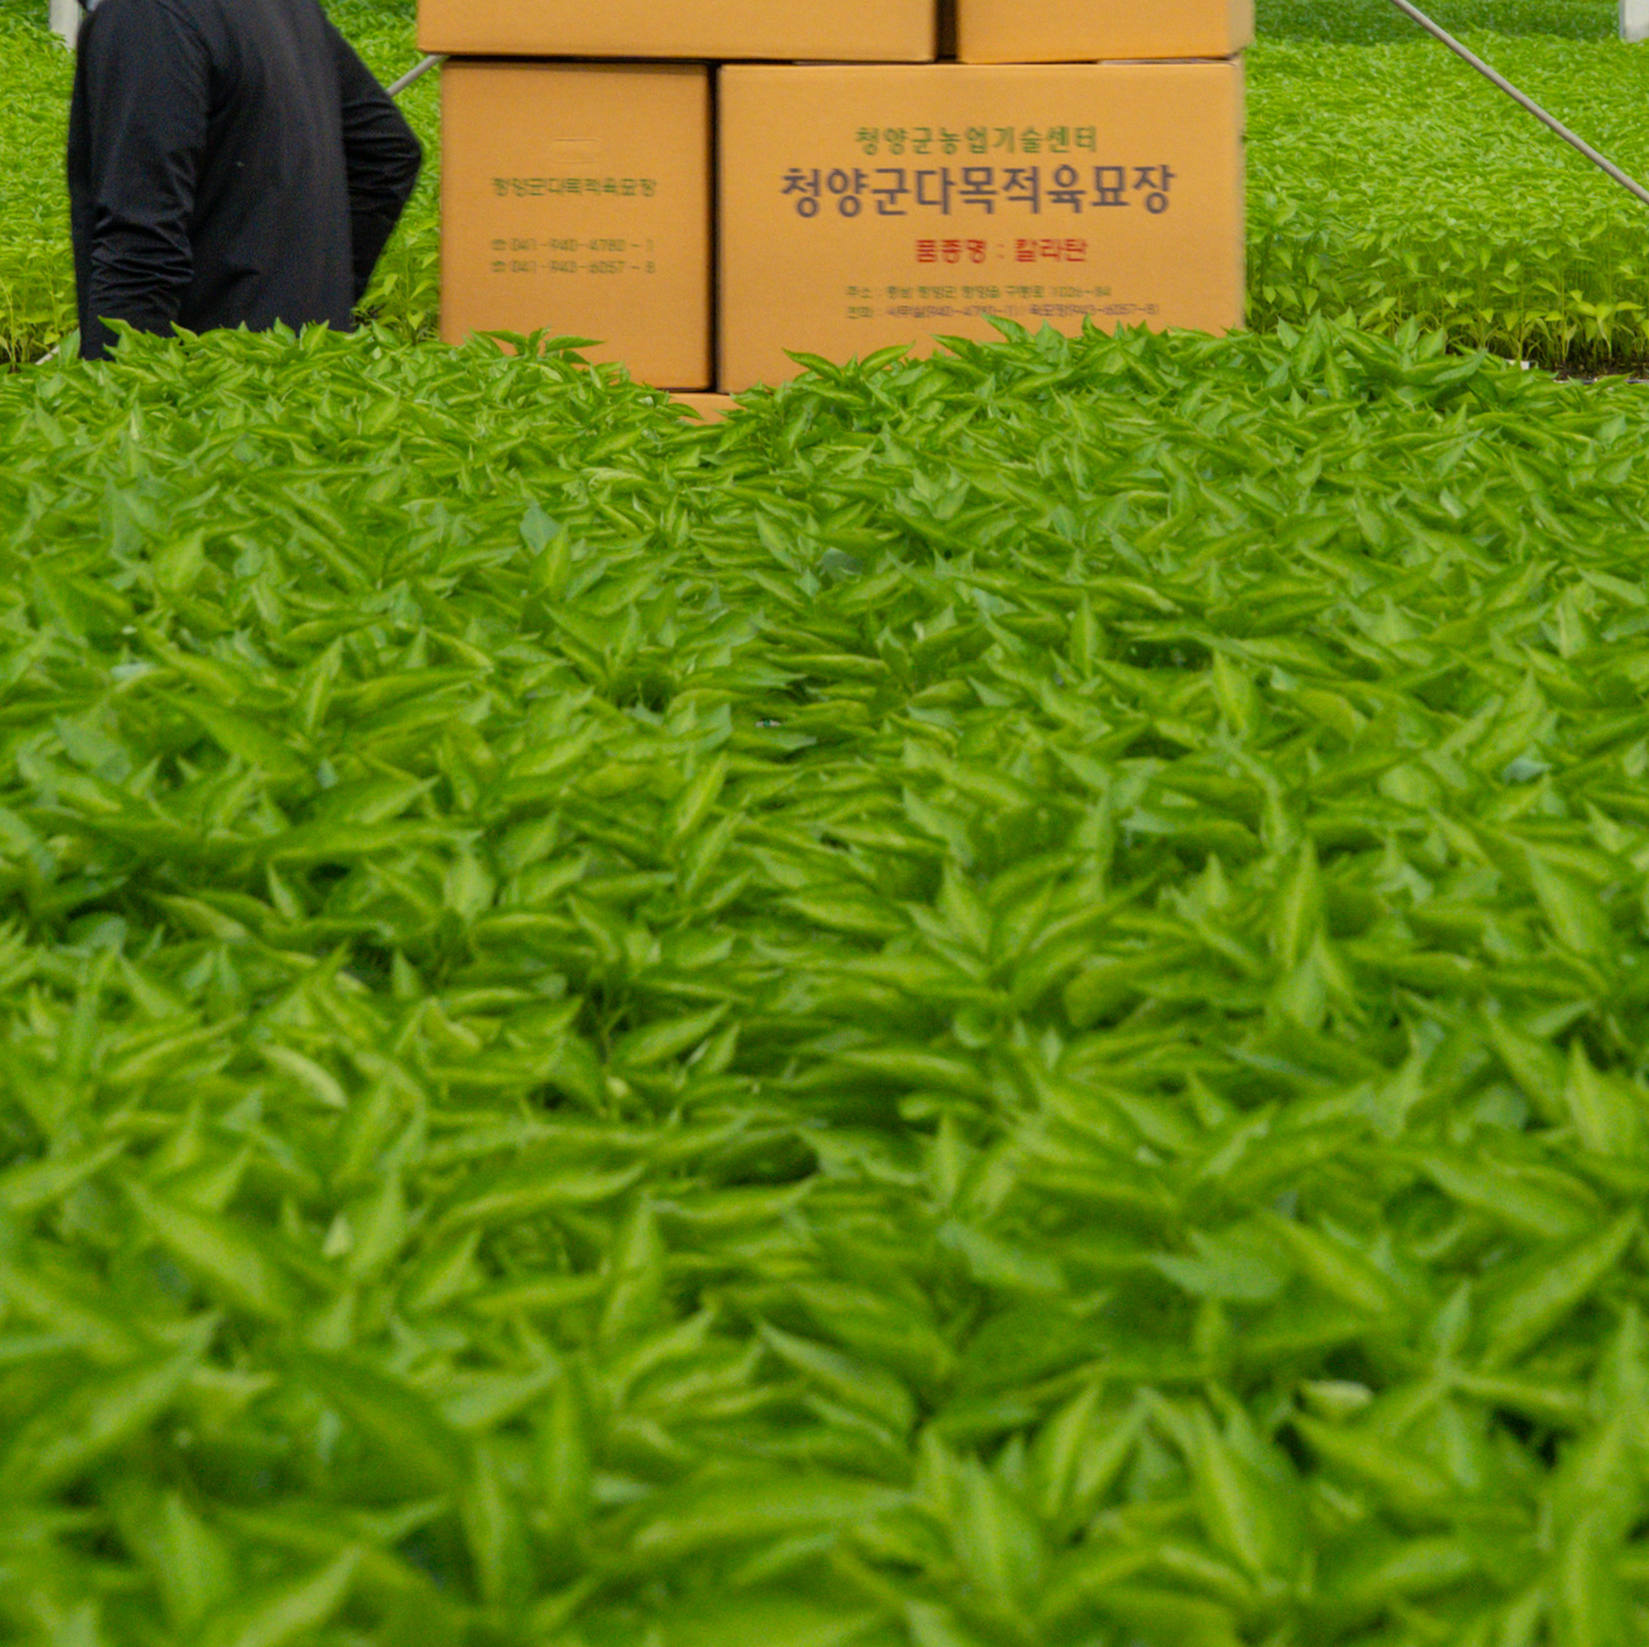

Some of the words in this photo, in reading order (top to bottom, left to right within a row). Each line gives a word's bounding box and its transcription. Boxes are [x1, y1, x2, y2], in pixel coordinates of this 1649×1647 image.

[854, 126, 1098, 156] 청양군농업기술센터
[492, 177, 657, 198] 청양군다목적육묘장
[781, 164, 1177, 218] 청양군다목적육묘장
[914, 238, 988, 265] 품종명
[1014, 238, 1089, 263] 칼라탄
